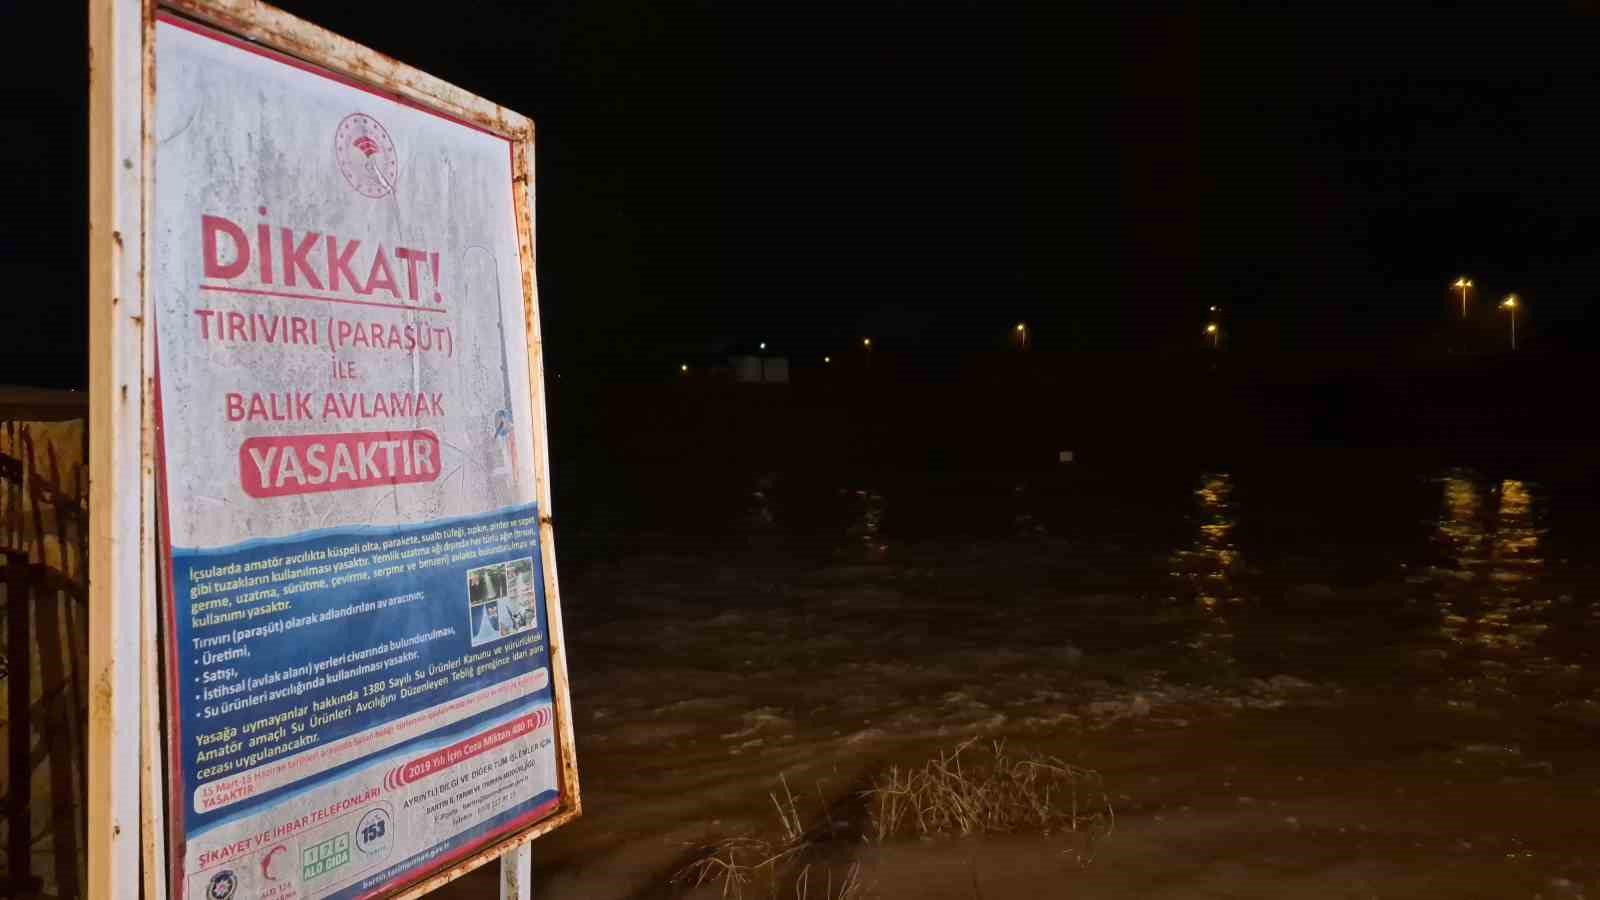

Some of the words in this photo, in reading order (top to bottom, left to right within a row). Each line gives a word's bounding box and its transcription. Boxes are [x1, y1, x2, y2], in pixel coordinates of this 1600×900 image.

[202, 206, 442, 304] DİKKAT!
[194, 309, 317, 344] TIRIVIRI
[327, 318, 453, 358] (PARAŞÜT)
[332, 355, 356, 380] İLE
[226, 392, 314, 422] BALIK
[323, 393, 445, 418] AVLAMAK
[249, 439, 436, 489] YASAKTIR
[190, 563, 241, 583] İçsularda
[244, 557, 282, 571] amatör
[286, 550, 326, 564] avcılıkta
[328, 544, 360, 559] küspeli
[191, 583, 212, 598] gibi
[214, 574, 269, 592] tuzakların
[271, 564, 331, 581] kullanılması
[191, 598, 232, 615] germe,
[236, 588, 280, 604] uzatma,
[192, 609, 246, 629] kullanımı
[248, 600, 292, 619] yasaktır.
[233, 621, 284, 642] (paraşüt)
[285, 614, 317, 628] olarak
[320, 601, 375, 620] adlandırılan
[376, 598, 386, 608] av
[202, 644, 250, 665] Üretimi,
[204, 680, 246, 700] İstihsal
[282, 663, 312, 680] alanı)
[314, 655, 346, 673] yerleri
[347, 644, 388, 661] civarında
[203, 666, 239, 685] Satışı,
[204, 705, 219, 718] Su
[221, 693, 267, 713] ürünleri
[269, 678, 324, 702] avcılığında
[326, 661, 383, 683] kullanılması
[195, 726, 237, 748] Yasağa
[242, 707, 308, 734] uymayanlar
[313, 690, 359, 710] hakkında
[363, 681, 385, 696] 1380
[389, 674, 411, 689] Sayılı
[415, 669, 425, 679] Su
[428, 658, 460, 675] Ürünleri
[196, 740, 242, 763] Amatör
[248, 727, 286, 749] amaçlı
[290, 721, 304, 734] Su
[310, 707, 351, 727] Ürünleri
[356, 693, 396, 714] Avcılığını
[400, 676, 448, 698] Düzenleyen
[196, 762, 232, 780] cezası
[236, 736, 320, 768] uygulanacaktır.
[408, 761, 431, 777] 2019
[202, 785, 255, 808] YASAKTIR
[199, 839, 251, 867] ŞİKAYET
[255, 832, 270, 845] VE
[273, 817, 308, 837] İHBAR
[313, 790, 381, 820] TELEFONLARI
[361, 819, 385, 844] 153
[325, 851, 349, 872] GIDA
